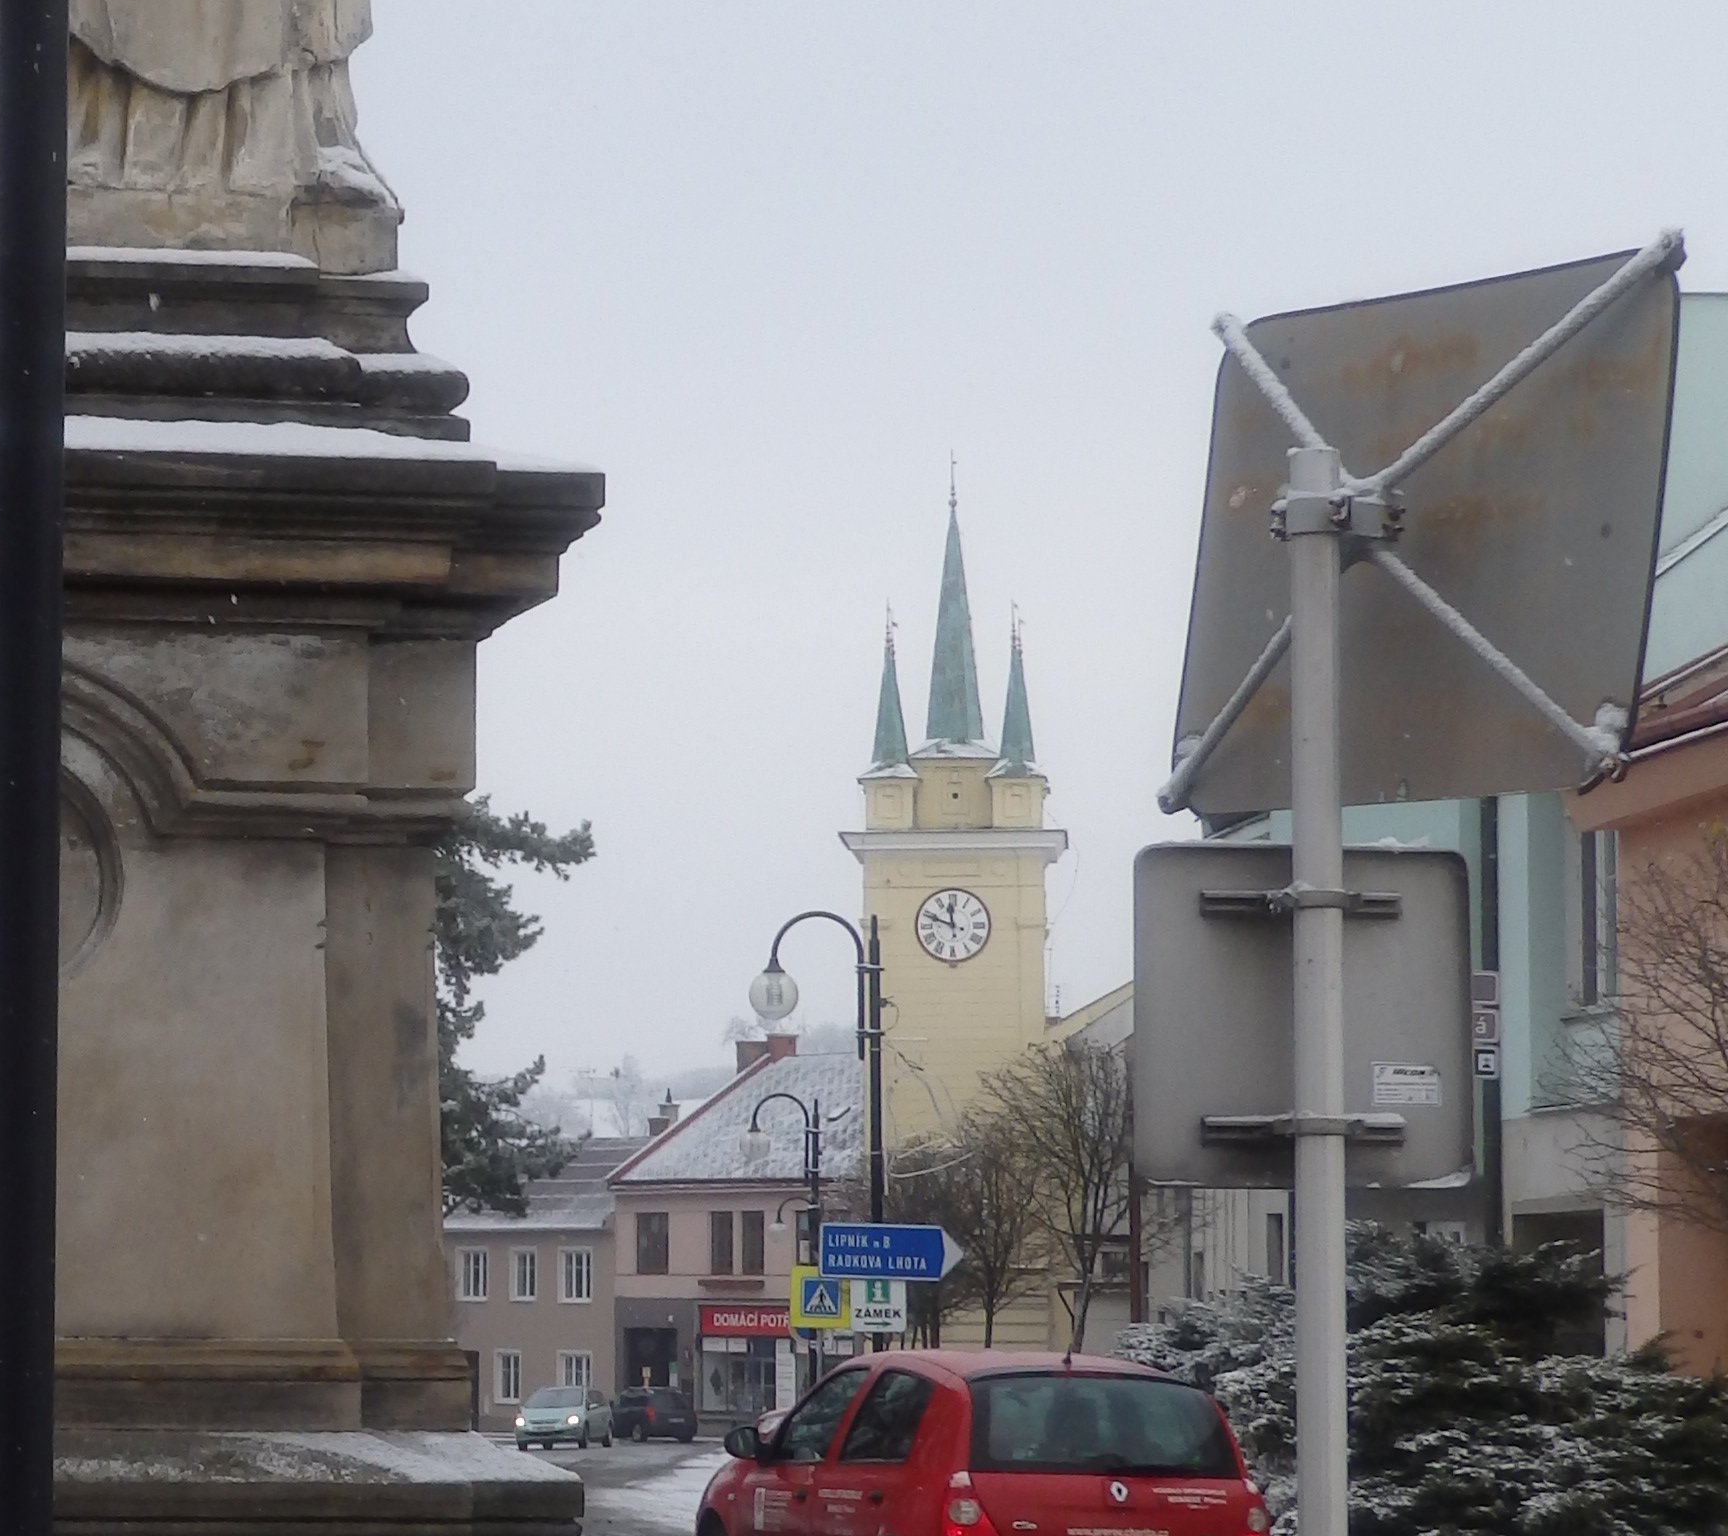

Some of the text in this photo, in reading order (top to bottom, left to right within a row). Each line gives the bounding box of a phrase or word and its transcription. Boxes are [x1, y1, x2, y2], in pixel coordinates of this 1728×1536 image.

[888, 1256, 927, 1270] LHOTA
[713, 1310, 758, 1327] DOMÁCÍ
[854, 1306, 902, 1319] ZÁMEK
